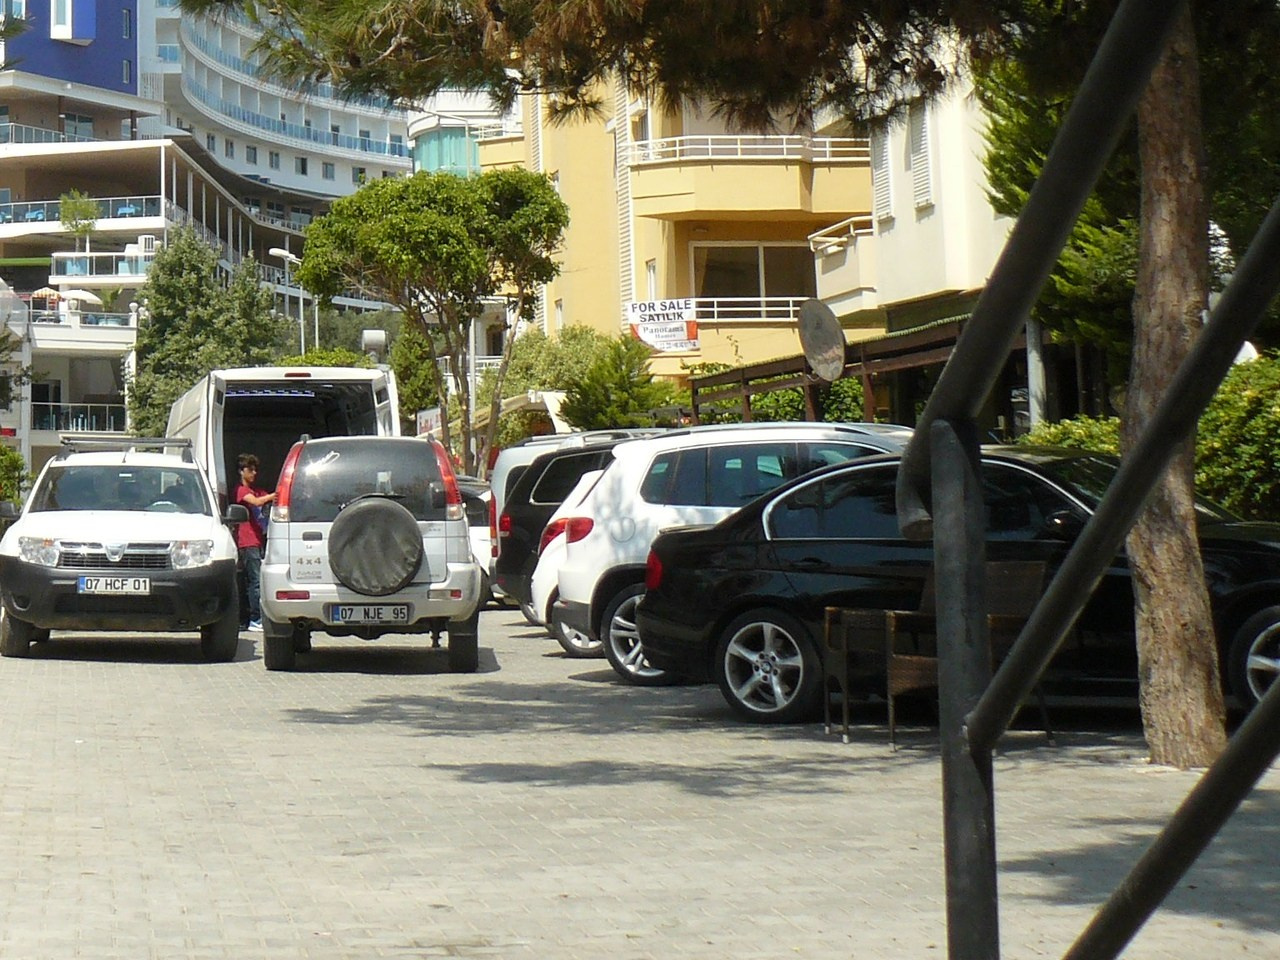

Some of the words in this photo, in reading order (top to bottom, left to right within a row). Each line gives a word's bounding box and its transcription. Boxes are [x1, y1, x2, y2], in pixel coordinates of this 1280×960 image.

[631, 302, 656, 313] FOR
[659, 300, 692, 311] SALE
[639, 311, 685, 323] SATILIK
[86, 578, 101, 590] 07
[105, 578, 128, 590] HCF
[133, 579, 147, 591] 01
[340, 607, 354, 620] 07
[363, 607, 383, 620] NJE
[392, 607, 406, 620] 95
